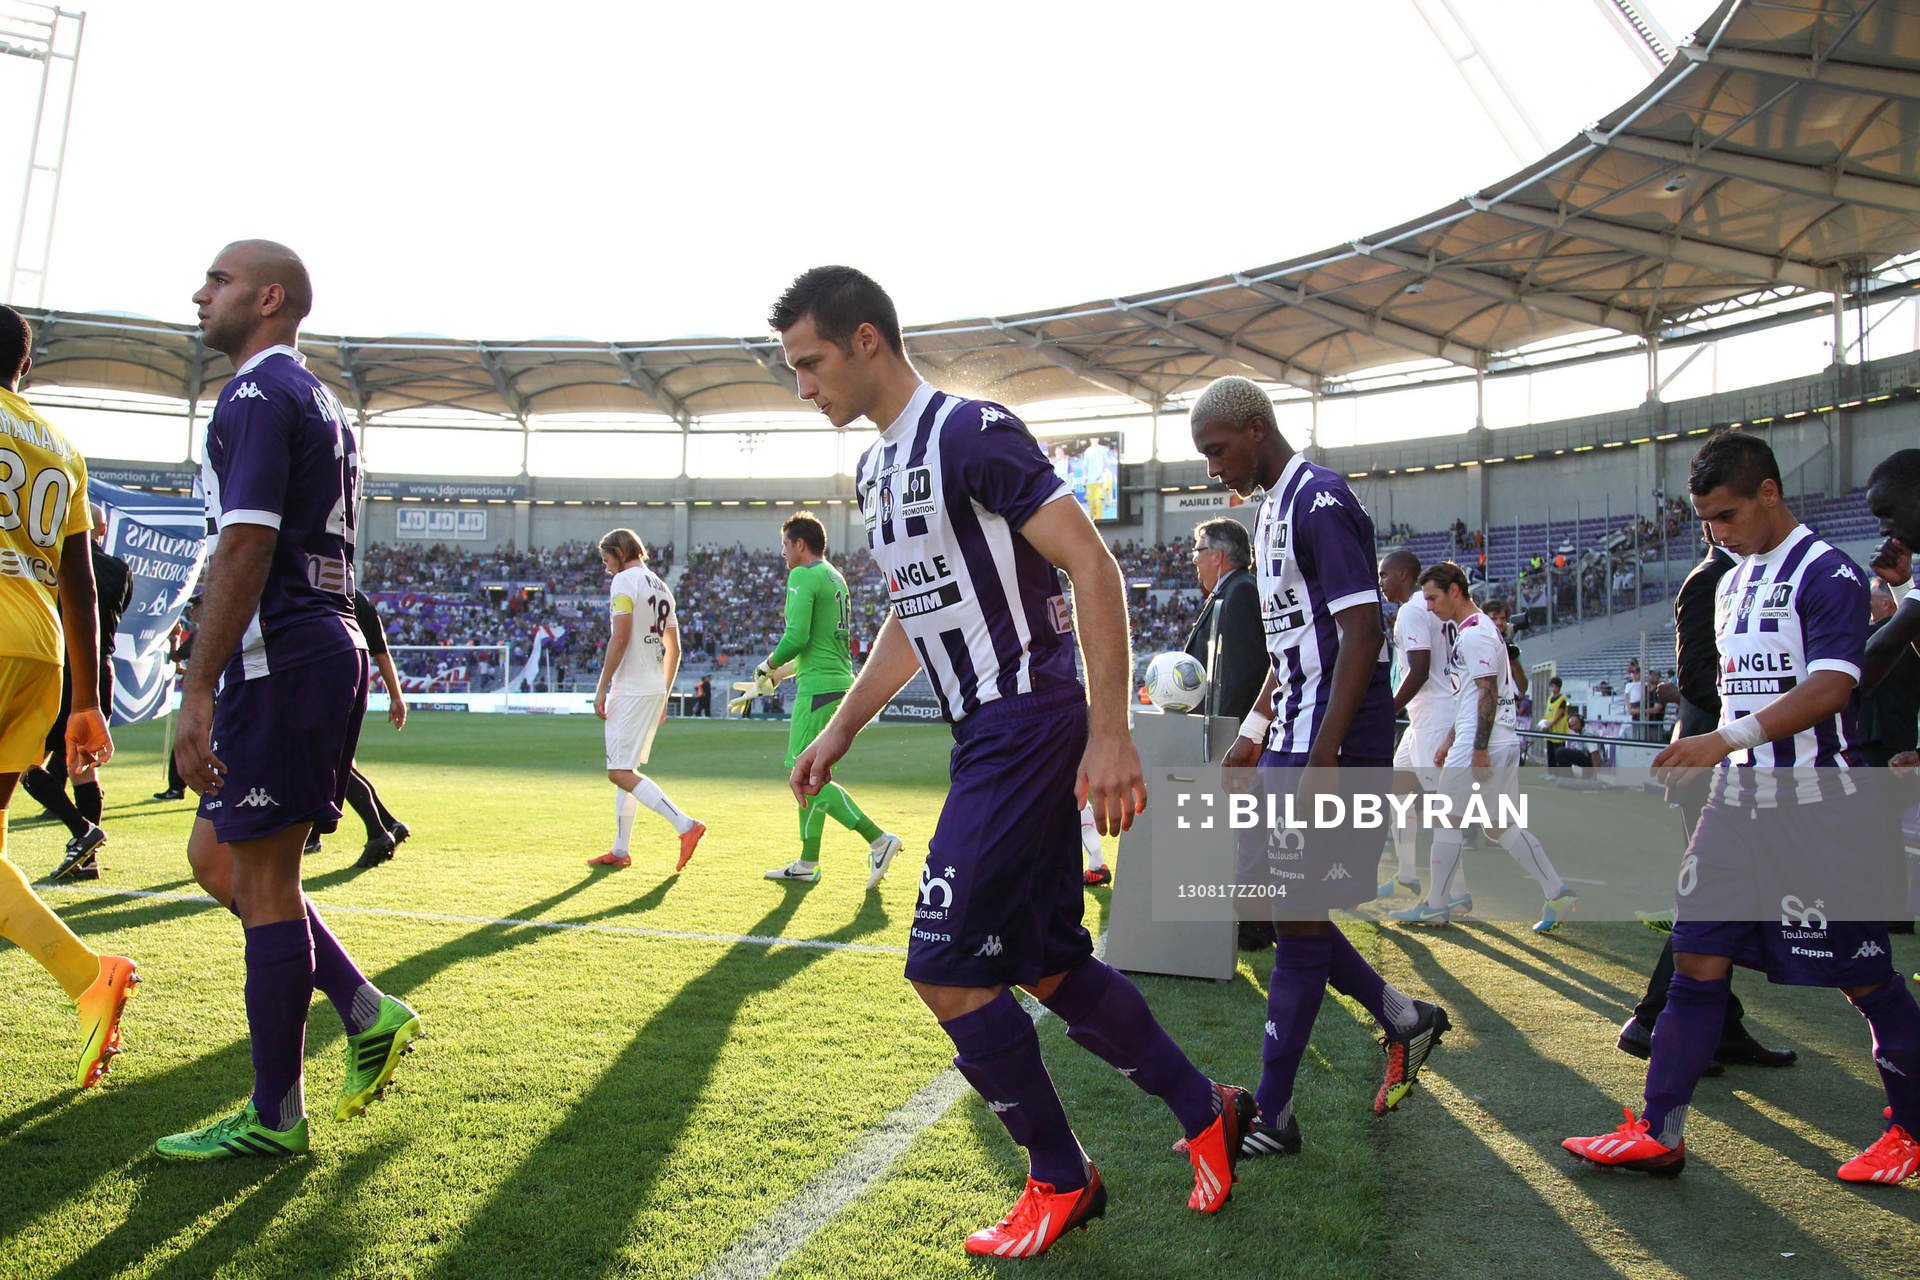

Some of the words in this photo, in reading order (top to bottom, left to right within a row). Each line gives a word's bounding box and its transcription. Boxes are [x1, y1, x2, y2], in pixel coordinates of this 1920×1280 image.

[409, 485, 516, 497] www.jdpromotion.fr
[903, 469, 932, 504] JD
[1180, 498, 1210, 507] MAIRIE
[1212, 496, 1223, 504] DE
[902, 504, 935, 517] PROMOTION
[1762, 583, 1793, 608] JD
[648, 594, 671, 637] 18
[1270, 867, 1305, 880] Kappa
[911, 927, 952, 942] Kappa
[1791, 945, 1833, 959] Kappa
